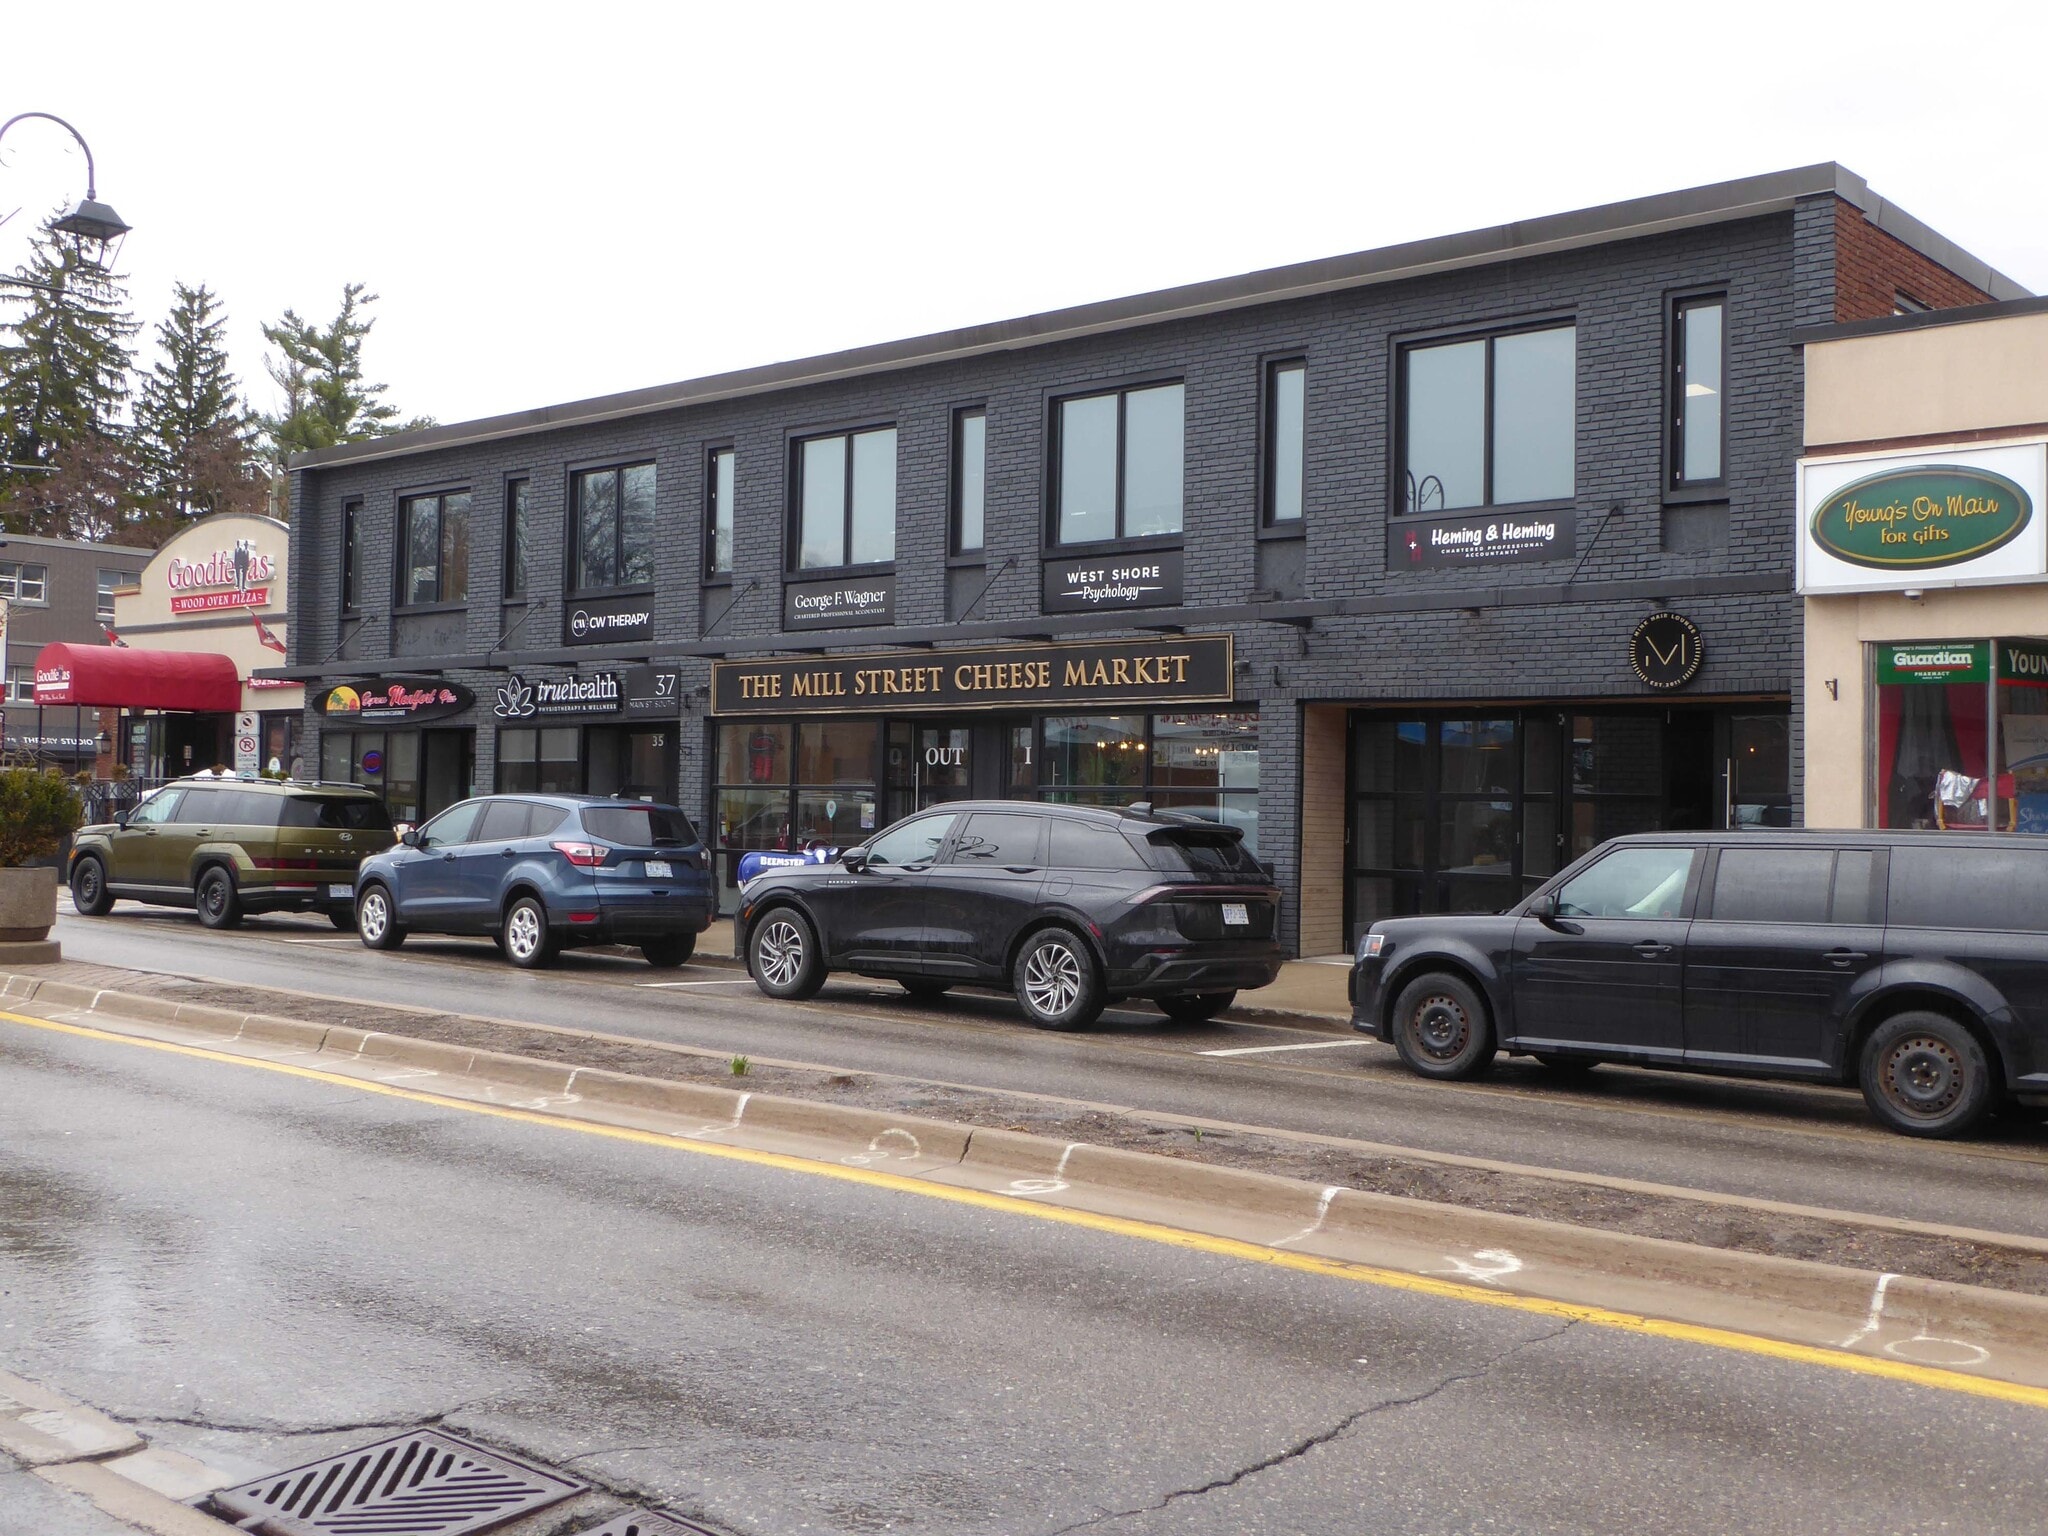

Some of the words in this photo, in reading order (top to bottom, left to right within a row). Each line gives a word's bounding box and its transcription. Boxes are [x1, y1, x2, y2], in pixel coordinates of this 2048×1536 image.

[1842, 500, 1908, 531] Young's
[1912, 496, 1943, 521] On
[1946, 494, 1999, 518] Main
[1431, 527, 1483, 546] Heming
[1485, 524, 1498, 541] &
[1502, 521, 1555, 540] Heming
[1912, 524, 1949, 545] gifts
[1440, 546, 1484, 554] CHARTERED
[1487, 542, 1544, 551] PROFESSIONAL
[1465, 549, 1519, 558] ACCOUNTANTS
[1067, 570, 1105, 584] WEST
[1111, 566, 1160, 580] SHORE
[181, 597, 205, 609] WOOD
[207, 596, 231, 607] OVEN
[232, 593, 257, 604] PIZZA
[794, 594, 833, 611] George
[834, 591, 843, 605] F.
[844, 590, 887, 608] Wagner
[1082, 583, 1139, 603] Psychology
[589, 616, 606, 629] CW
[607, 612, 650, 627] THERAPY
[794, 612, 821, 620] CHARTERED
[820, 610, 854, 618] PROFESSIONAL
[855, 607, 886, 615] ACCOUNTANT
[1650, 613, 1668, 622] HAIR
[1670, 614, 1697, 634] LOUNGE
[1893, 651, 1973, 666] Guardian
[655, 674, 676, 696] 37
[738, 674, 782, 699] THE
[790, 672, 847, 697] MILL
[854, 666, 944, 695] STREET
[953, 661, 1051, 691] CHEESE
[1062, 655, 1191, 687] MARKET
[537, 673, 618, 702] truehealth
[538, 704, 581, 712] PHYSIOTHERAPY
[652, 735, 664, 747] 35
[925, 747, 965, 766] OUT
[304, 847, 357, 855] SANTA
[760, 856, 805, 866] BEEMSTER
